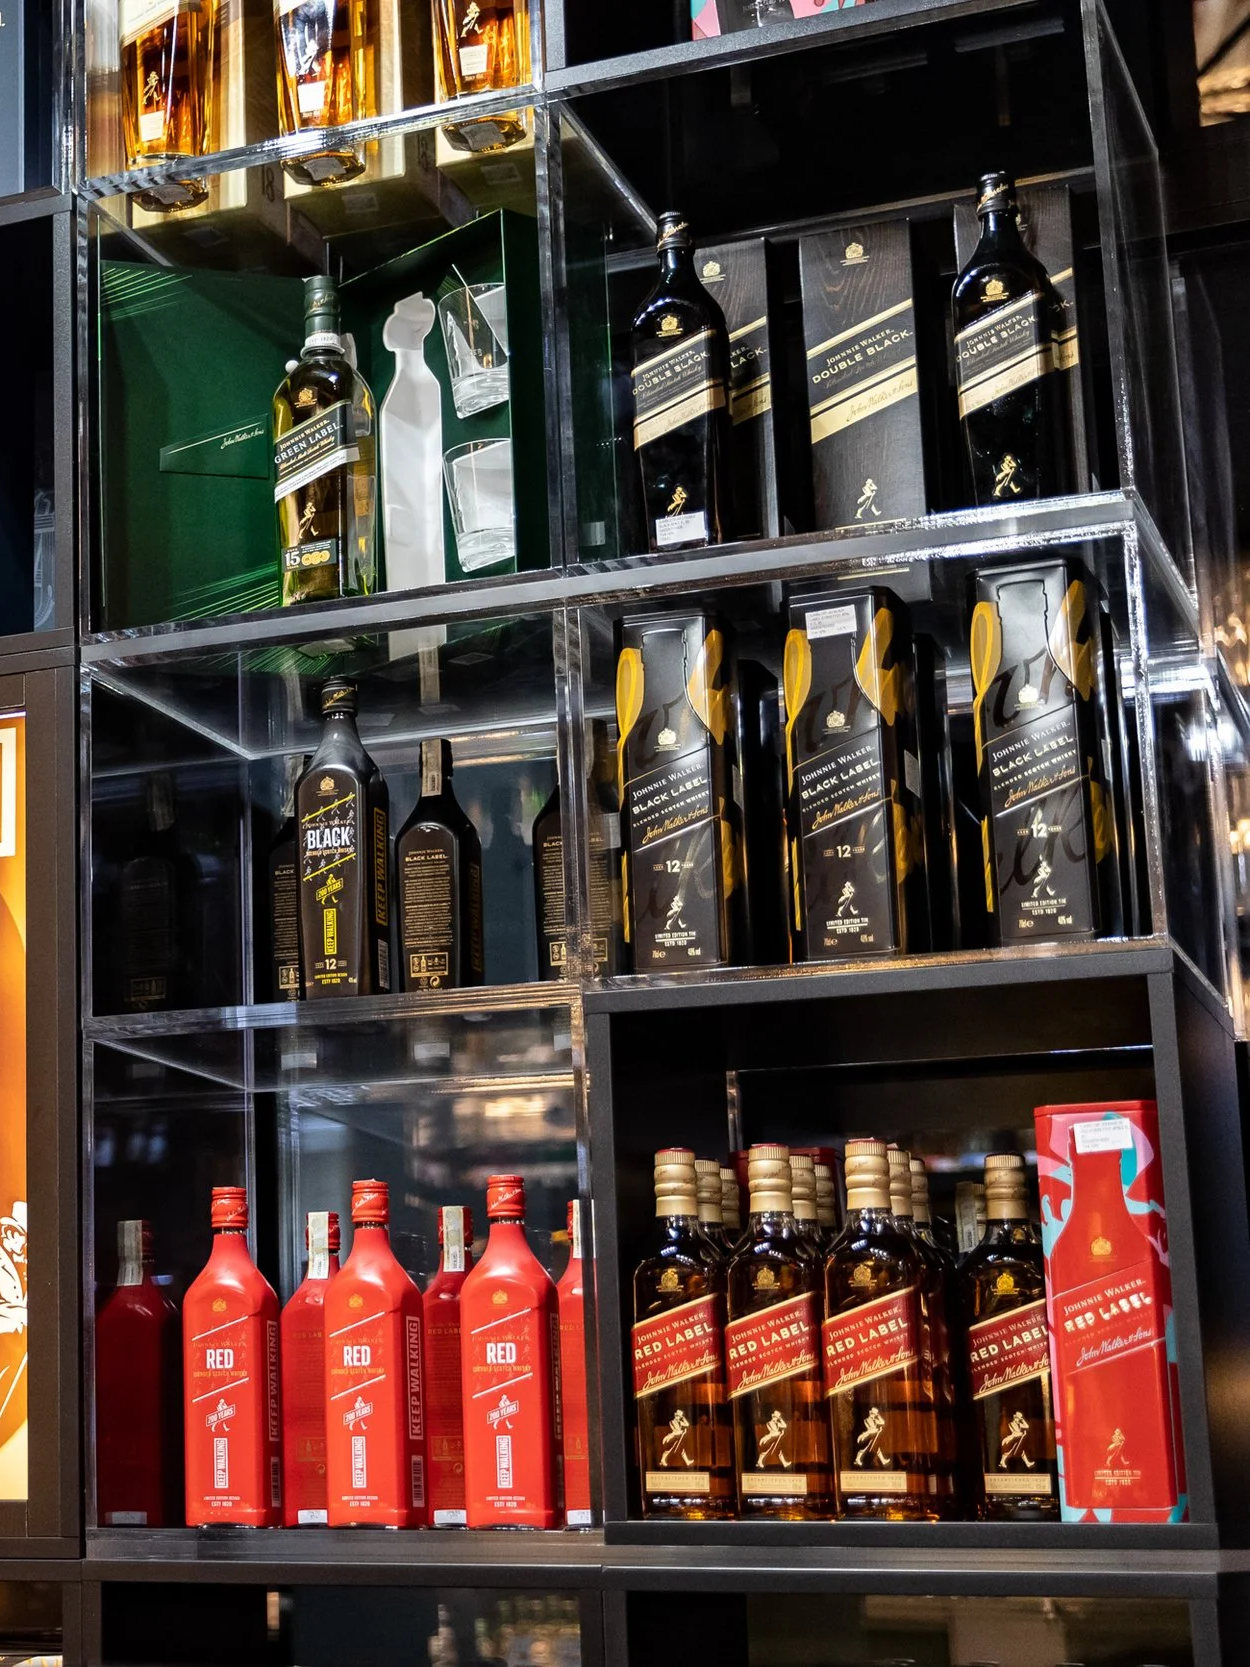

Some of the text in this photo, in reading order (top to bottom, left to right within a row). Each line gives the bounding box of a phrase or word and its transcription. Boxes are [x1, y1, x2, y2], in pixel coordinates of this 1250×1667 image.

[826, 328, 891, 367] JOHNNIE WALKER
[956, 315, 1036, 362] DOUBLE BLACK
[633, 350, 709, 396] DOUBLE BLACK
[812, 329, 910, 384] DOUBLE BLACK
[274, 441, 307, 464] GREEN
[285, 551, 301, 566] 15
[992, 721, 1067, 762] JOHNNIE WALKER
[992, 735, 1073, 777] BLACK LABEL
[632, 763, 702, 800] JOHNNIE WALKER
[801, 745, 872, 785] JOHNNIE WALKER
[801, 758, 878, 800] BLACK LABEL
[632, 776, 707, 815] BLACK LABEL
[1004, 787, 1027, 808] John
[642, 825, 664, 844] John
[812, 810, 833, 830] John
[1031, 823, 1048, 838] 12
[307, 826, 350, 850] BLACK
[836, 845, 851, 858] 12
[376, 808, 386, 920] KEEP WALKING
[665, 859, 680, 873] 12
[325, 959, 337, 970] 12
[1064, 1278, 1143, 1316] JOHNNIE WALKER
[1064, 1311, 1095, 1333] RED
[1099, 1292, 1152, 1320] LABEL
[637, 1312, 705, 1345] JOHNNIE WALKER
[729, 1321, 809, 1360] RED LABEL
[731, 1311, 800, 1344] JOHNNIE WALKER
[826, 1317, 908, 1357] RED LABEL
[829, 1306, 899, 1341] JOHNNIE WALKER
[973, 1328, 1007, 1348] JOHNNIE
[1008, 1313, 1042, 1332] WALKER
[343, 1345, 371, 1366] RED
[486, 1342, 516, 1364] RED
[634, 1322, 713, 1360] RED LABEL
[970, 1344, 999, 1363] RED
[1076, 1346, 1100, 1367] John
[1100, 1335, 1128, 1354] Walker
[206, 1348, 234, 1369] RED
[642, 1370, 667, 1390] John
[667, 1360, 694, 1378] Walker
[737, 1370, 762, 1391] John
[761, 1359, 791, 1378] Walker
[835, 1367, 860, 1389] John
[860, 1355, 891, 1376] Walker
[269, 1323, 278, 1437] KEEP WALKING
[410, 1322, 421, 1434] KEEP WALKING
[979, 1362, 1035, 1394] John Walker
